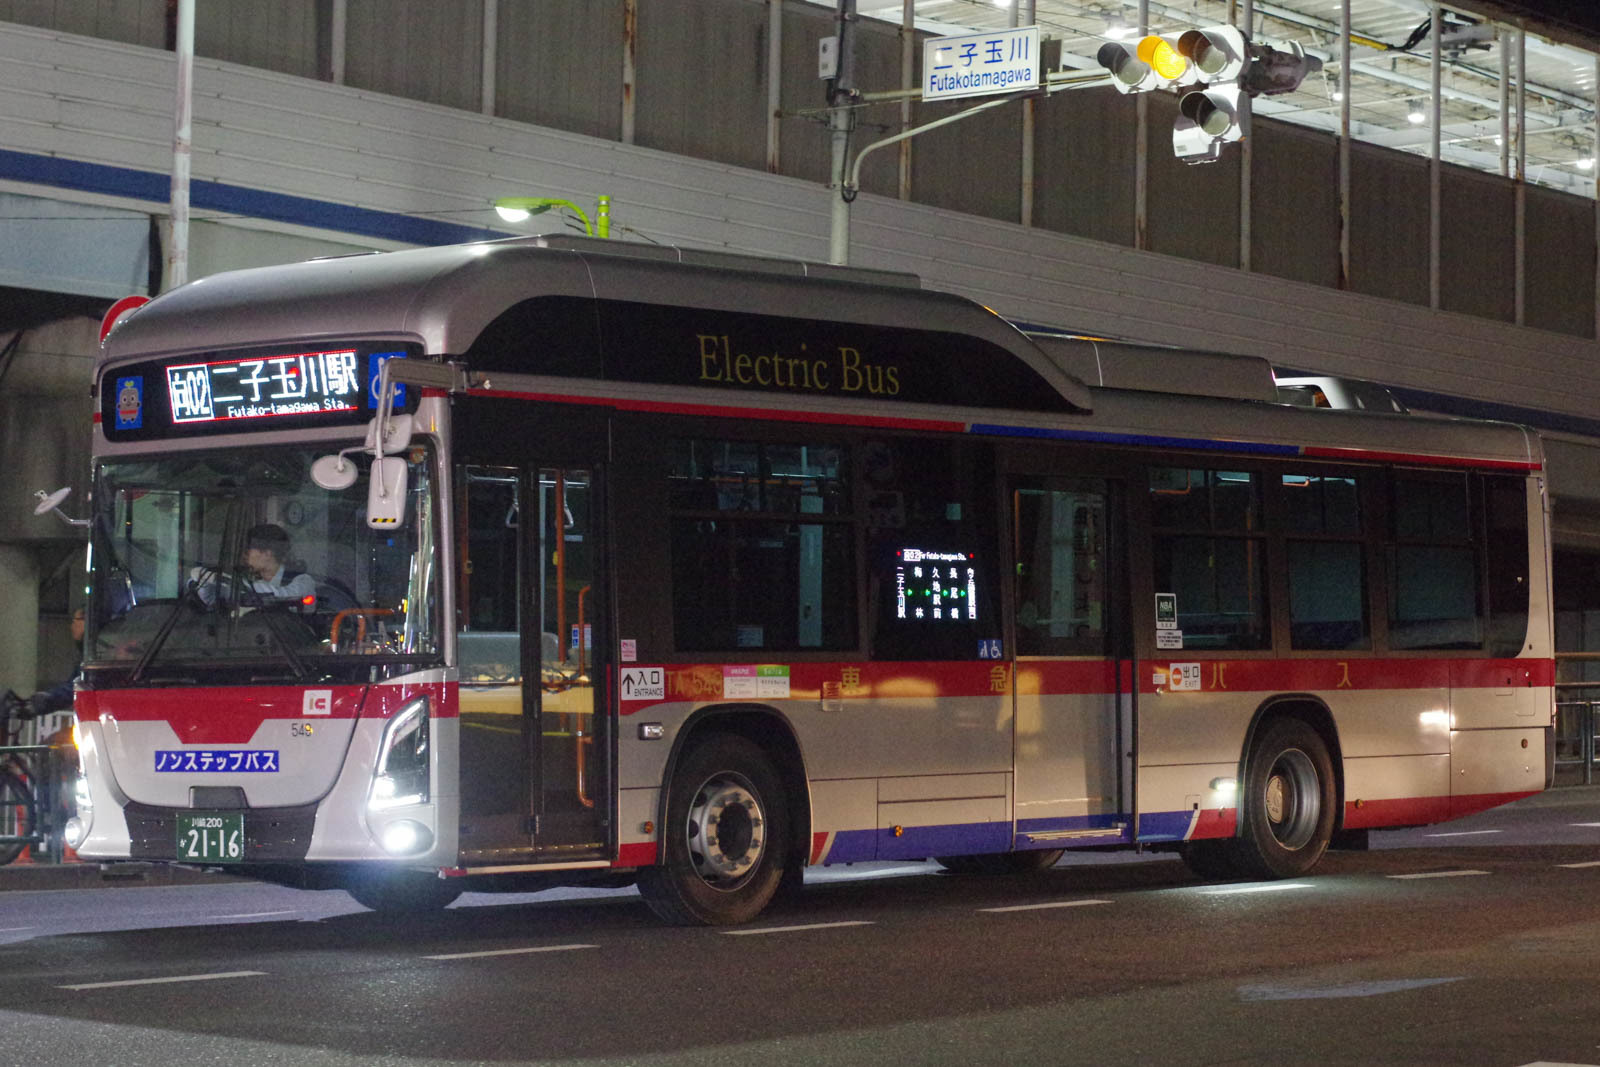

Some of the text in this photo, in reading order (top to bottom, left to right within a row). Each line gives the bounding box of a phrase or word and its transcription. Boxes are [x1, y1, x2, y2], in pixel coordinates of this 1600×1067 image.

[934, 36, 1028, 70] 二子玉川
[930, 68, 1031, 92] Futakotamagawa
[697, 334, 900, 395] Electric Bus
[171, 352, 359, 416] 向02 二子玉川駅
[228, 398, 350, 418] Futako-tamagawa Sta.
[638, 671, 660, 685] 入口
[1183, 666, 1199, 679] 出口
[634, 688, 664, 698] ENTRANCE
[156, 752, 277, 771] ノンステップバス
[187, 828, 240, 858] 21-16
